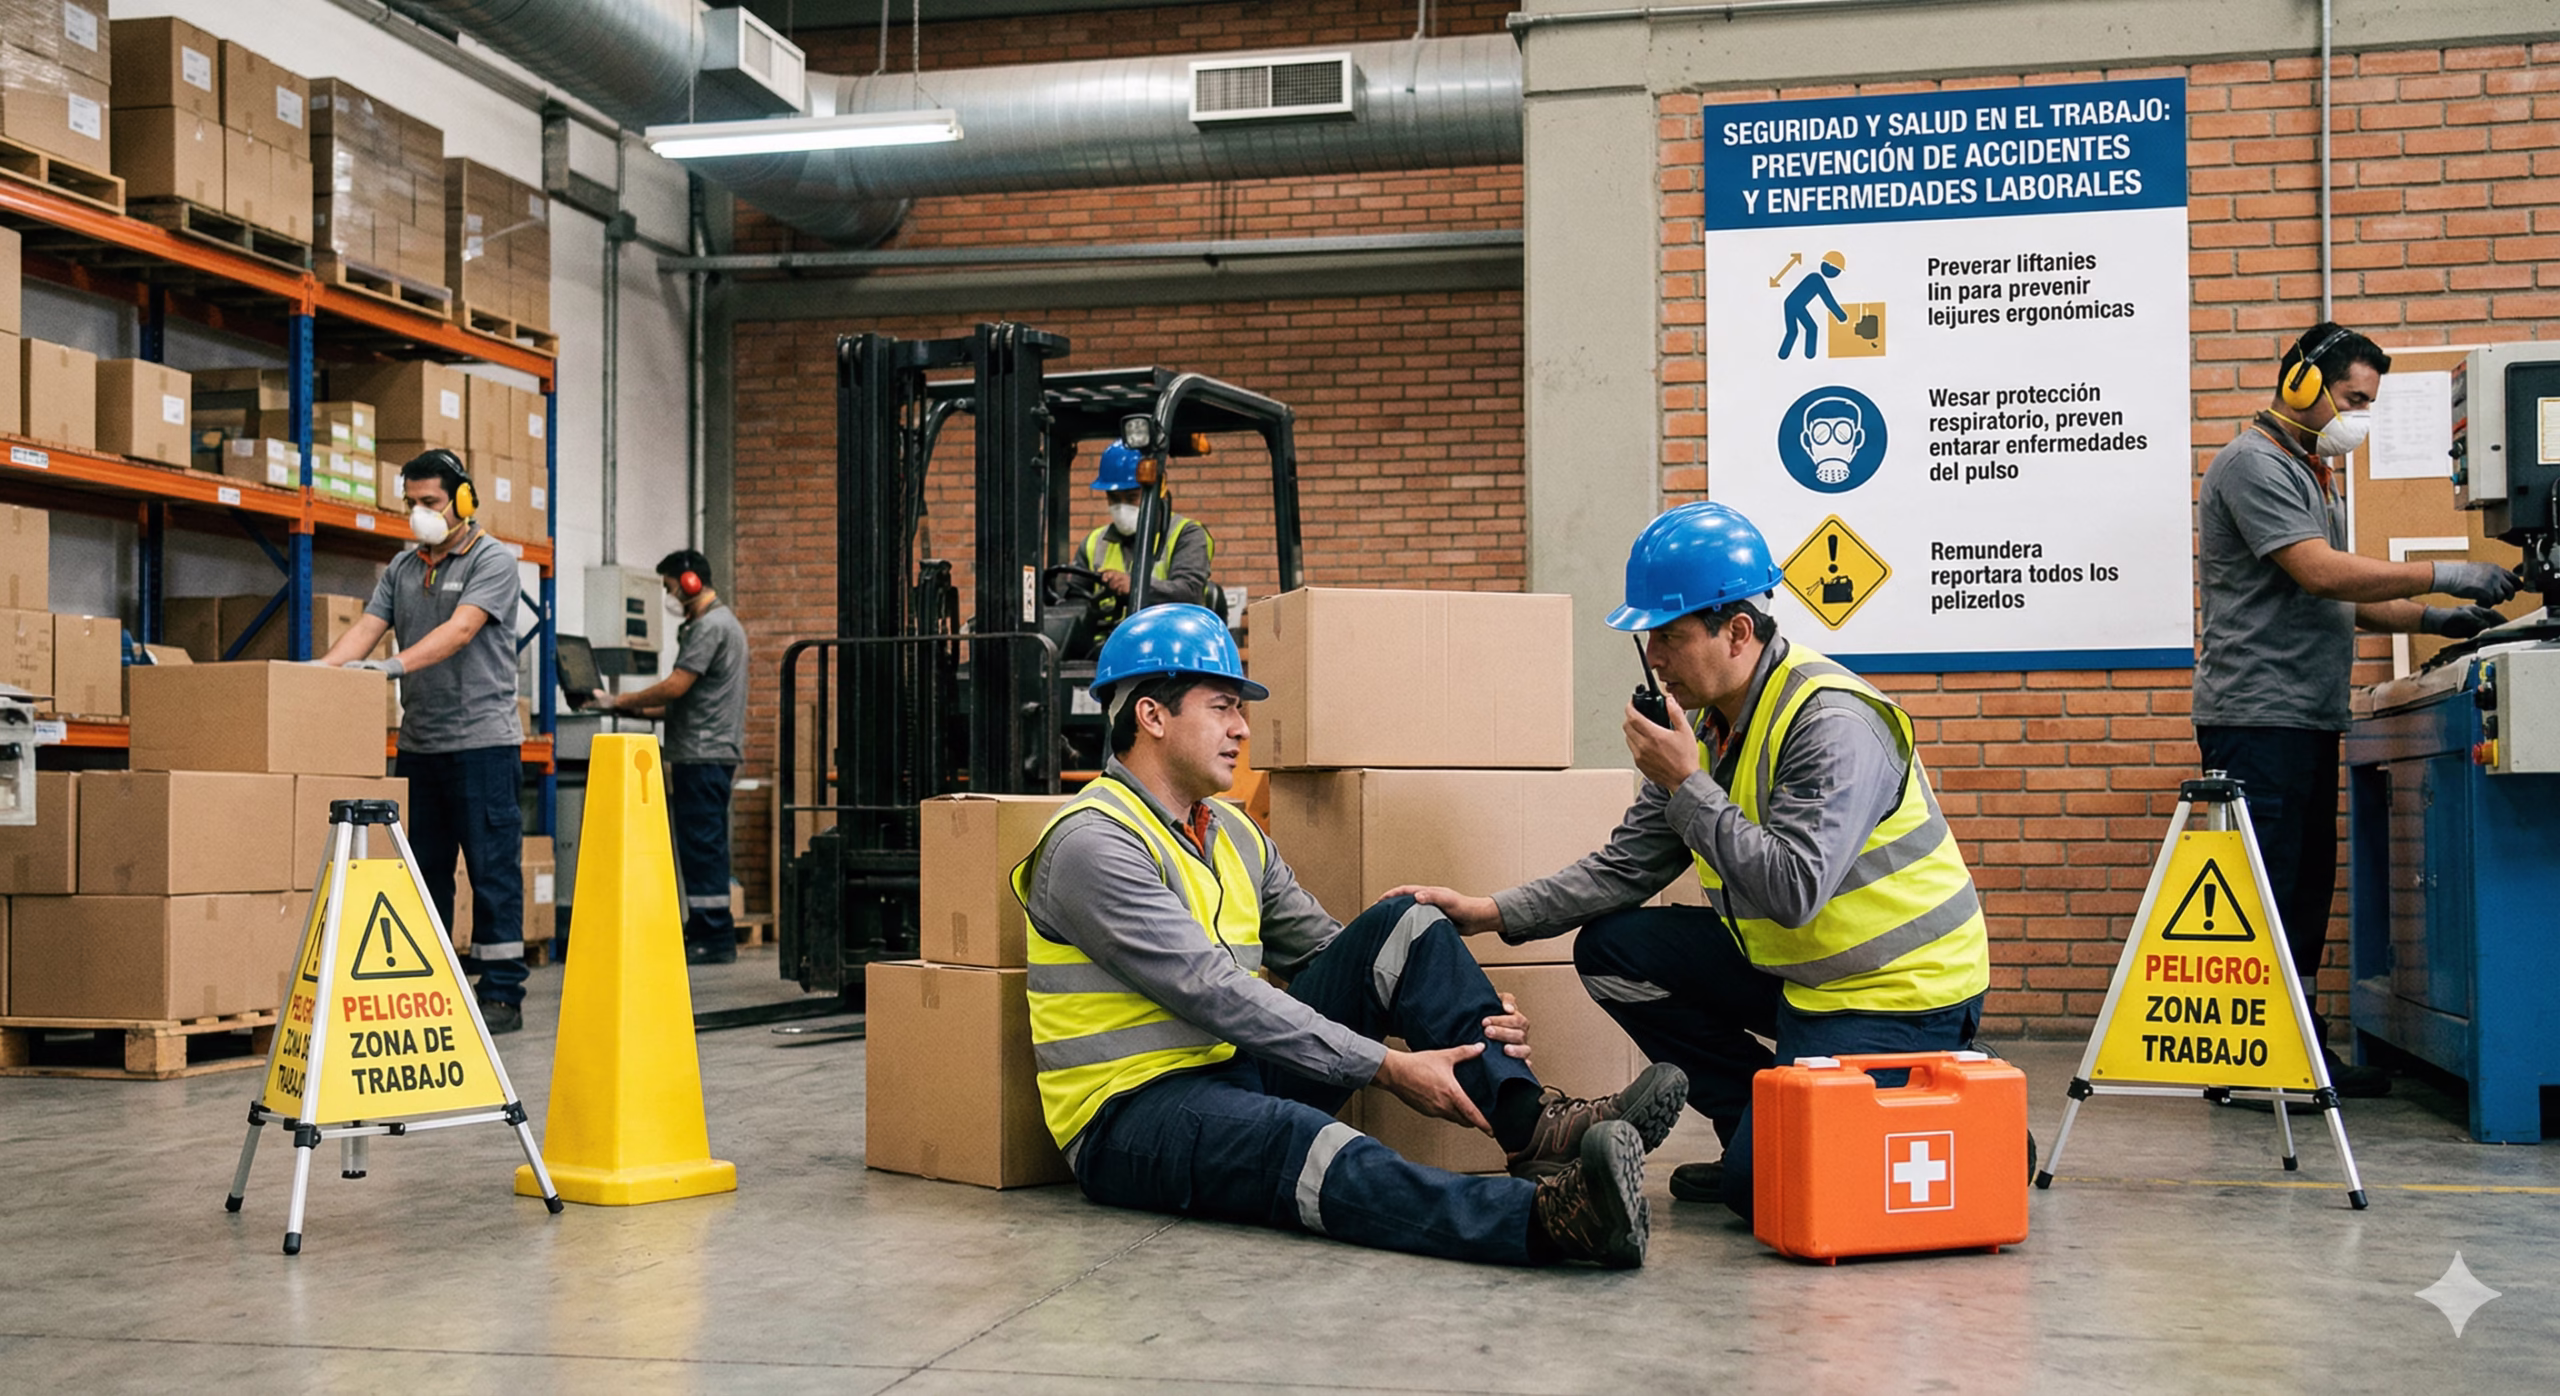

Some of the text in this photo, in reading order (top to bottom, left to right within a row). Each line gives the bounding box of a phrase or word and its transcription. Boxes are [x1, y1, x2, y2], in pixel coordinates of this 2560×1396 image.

[1723, 98, 2169, 145] SEGURIDAD Y SALUD EN EL TRABAJO:
[1752, 134, 2130, 178] PREVENCIÓN DE ACCIDENTES
[1743, 169, 2141, 214] Y ENFERMEDADES LABORALES
[1928, 252, 2096, 276] Preverar liftanies
[1928, 276, 2090, 304] lin para prevenir
[1928, 300, 2134, 329] leijures ergonómicas
[1929, 382, 2100, 409] Wesar protección
[1930, 410, 2122, 435] respiratorio, preven
[1930, 433, 2147, 456] entarar enfermedades
[1930, 461, 2018, 484] del pulso
[1931, 540, 2043, 560] Remundera
[1931, 563, 2119, 589] reportara todos los
[2145, 954, 2269, 985] PELIGRO:
[342, 991, 452, 1022] PELIGRO:
[2145, 996, 2265, 1026] ZONA DE
[350, 1026, 455, 1059] ZONA DE
[2142, 1034, 2268, 1067] TRABAJO
[352, 1060, 464, 1095] TRABAJO
